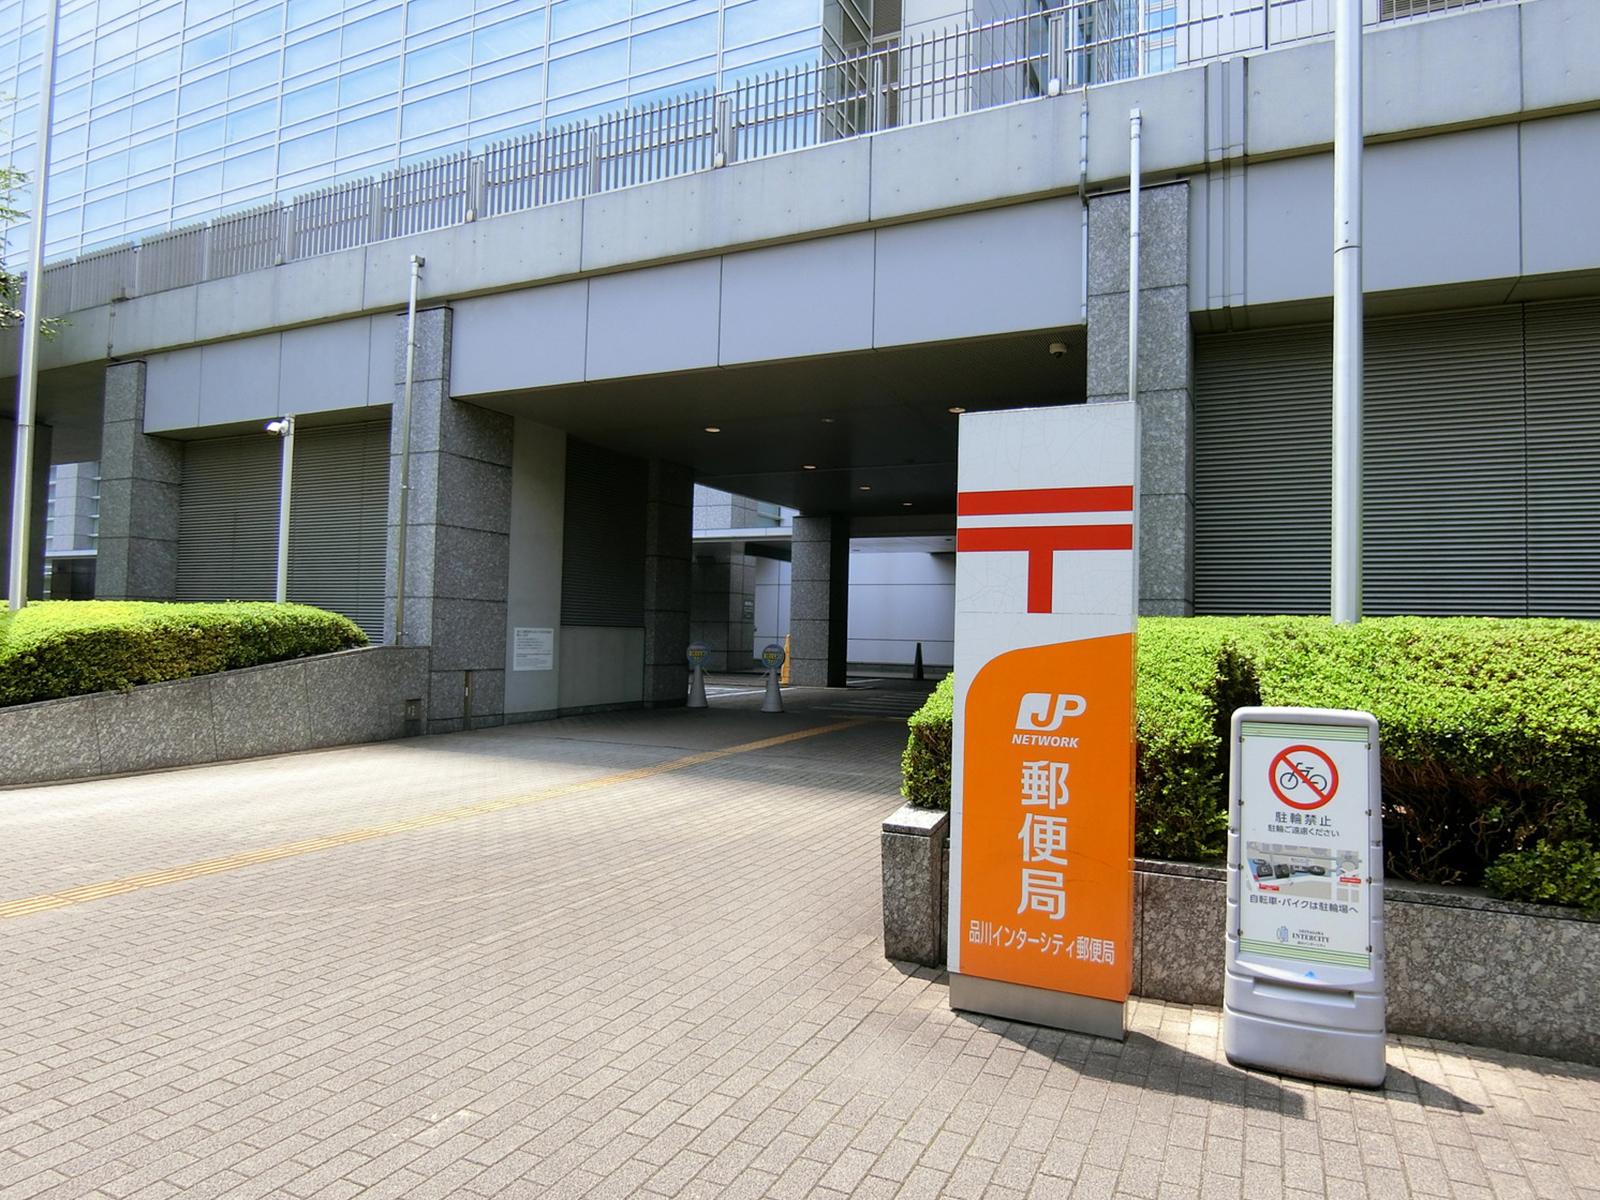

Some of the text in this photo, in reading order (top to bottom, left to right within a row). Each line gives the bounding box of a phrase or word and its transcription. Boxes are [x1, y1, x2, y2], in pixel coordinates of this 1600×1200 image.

[1015, 692, 1087, 731] JP
[1012, 734, 1079, 748] NETWORK
[1275, 811, 1332, 827] 駐輪禁止
[1267, 824, 1340, 837] 駐輪ご遠慮ください
[1017, 760, 1070, 920] 郵便局
[1249, 894, 1359, 914] 自転車・バイクは駐輪場へ
[969, 919, 1115, 965] 品川インターシティ郵便局
[1292, 932, 1330, 943] INTERCITY
